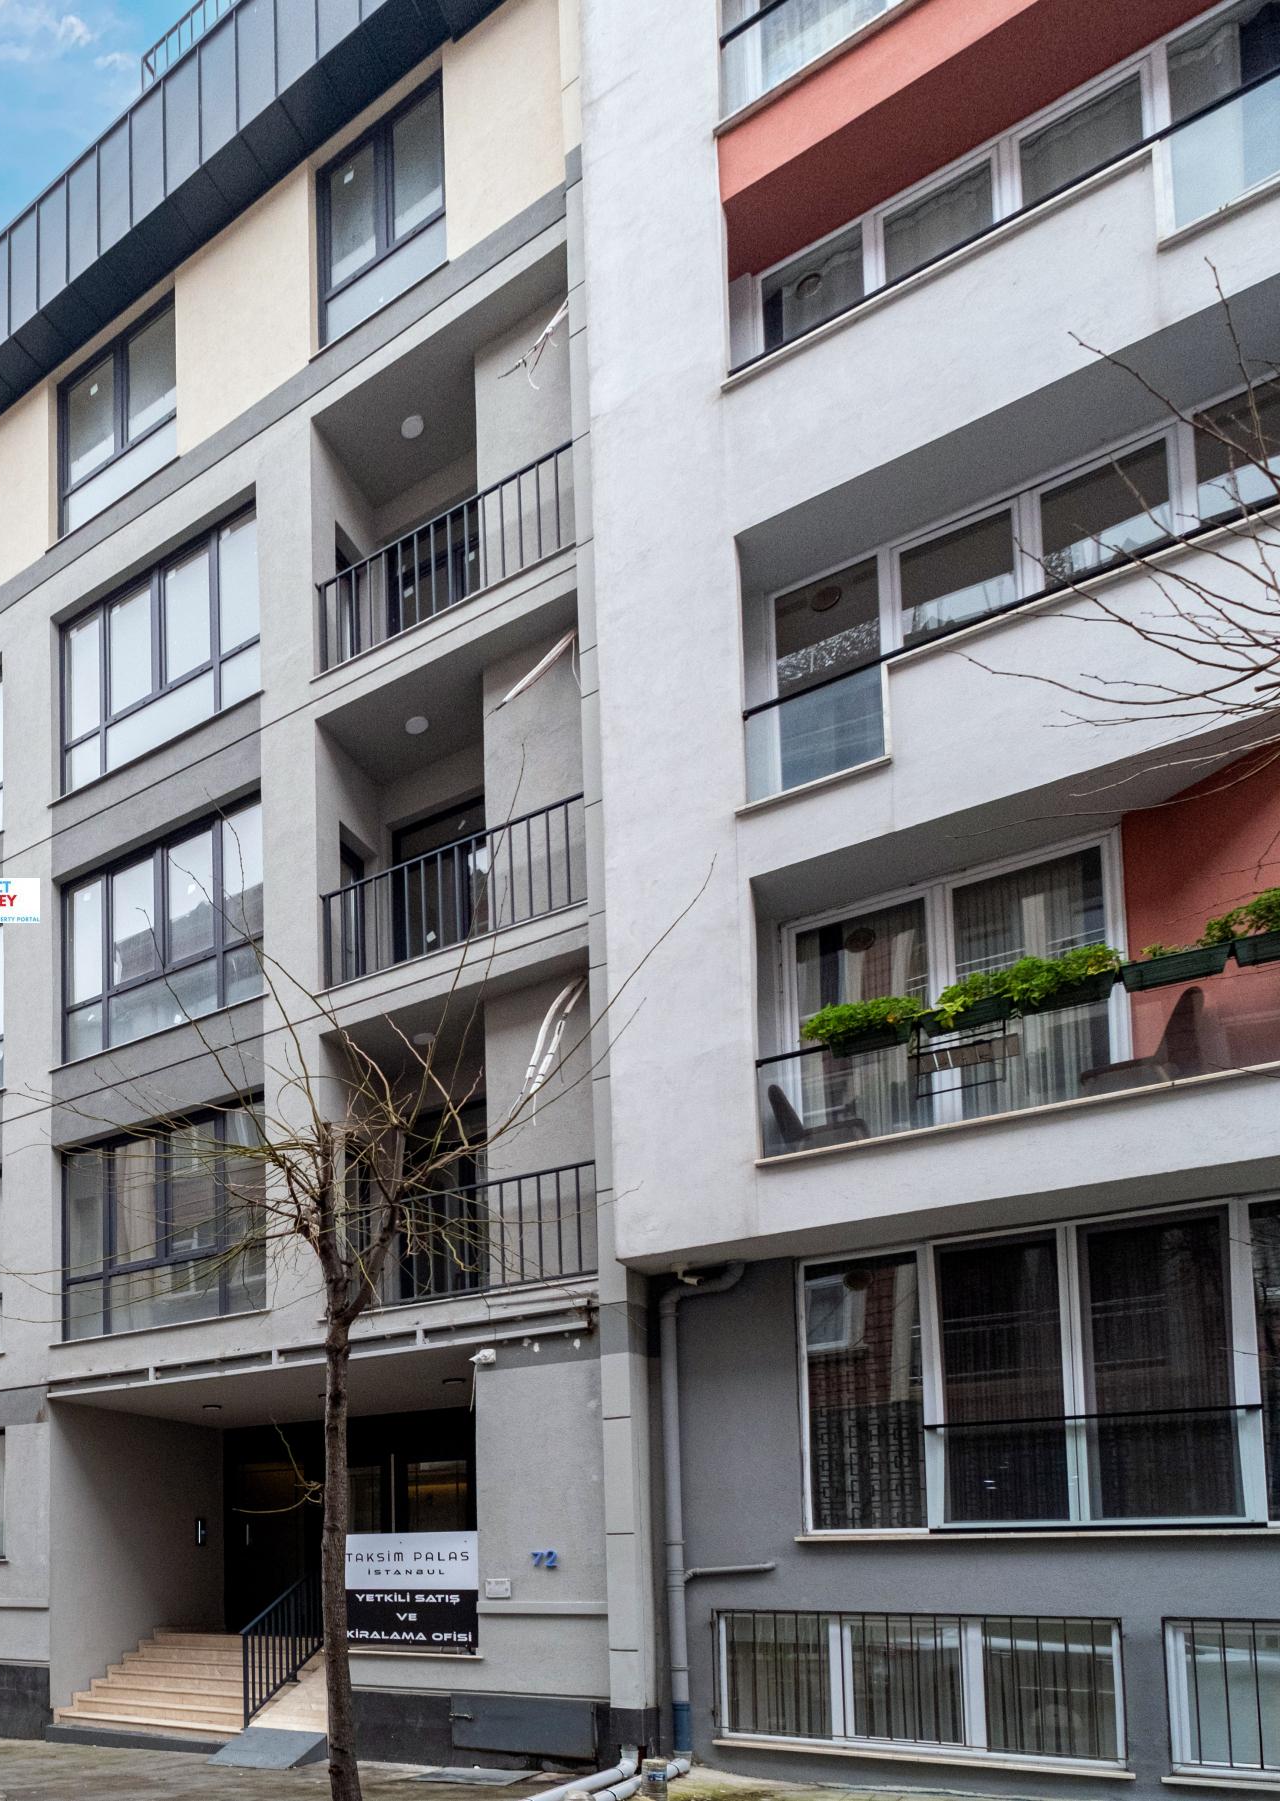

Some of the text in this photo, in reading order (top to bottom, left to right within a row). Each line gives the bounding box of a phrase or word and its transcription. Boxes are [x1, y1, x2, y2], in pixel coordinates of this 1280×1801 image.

[413, 1551, 470, 1561] PALAS
[530, 1550, 558, 1568] 72
[355, 1592, 460, 1606] YETKİLİ SATIŞ
[396, 1612, 418, 1622] VE
[346, 1628, 472, 1642] KİRALAMA OFİSİ
